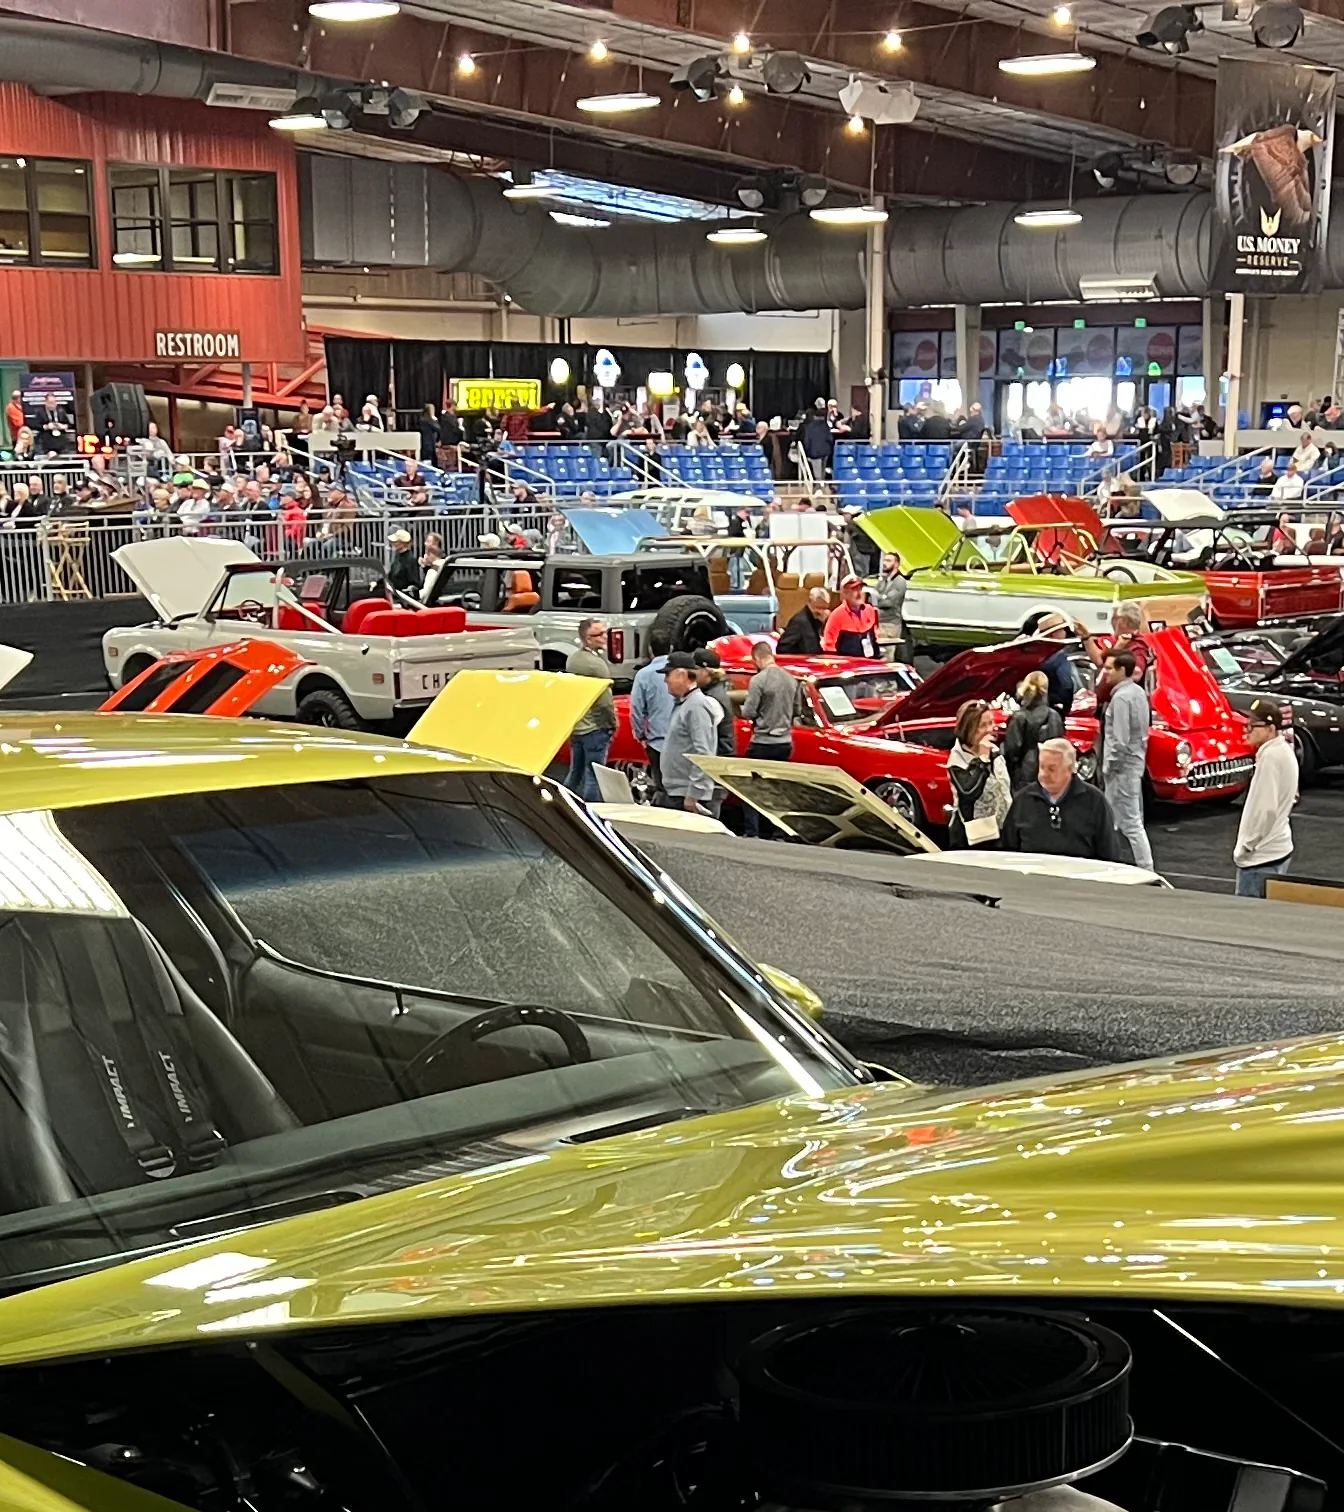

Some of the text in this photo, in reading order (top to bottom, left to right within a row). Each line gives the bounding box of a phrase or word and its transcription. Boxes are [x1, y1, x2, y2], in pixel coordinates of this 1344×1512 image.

[1256, 236, 1301, 254] MONEY
[156, 332, 239, 357] RESTROOM
[101, 1055, 134, 1121] IMPACT
[158, 1050, 193, 1116] IMPACT
